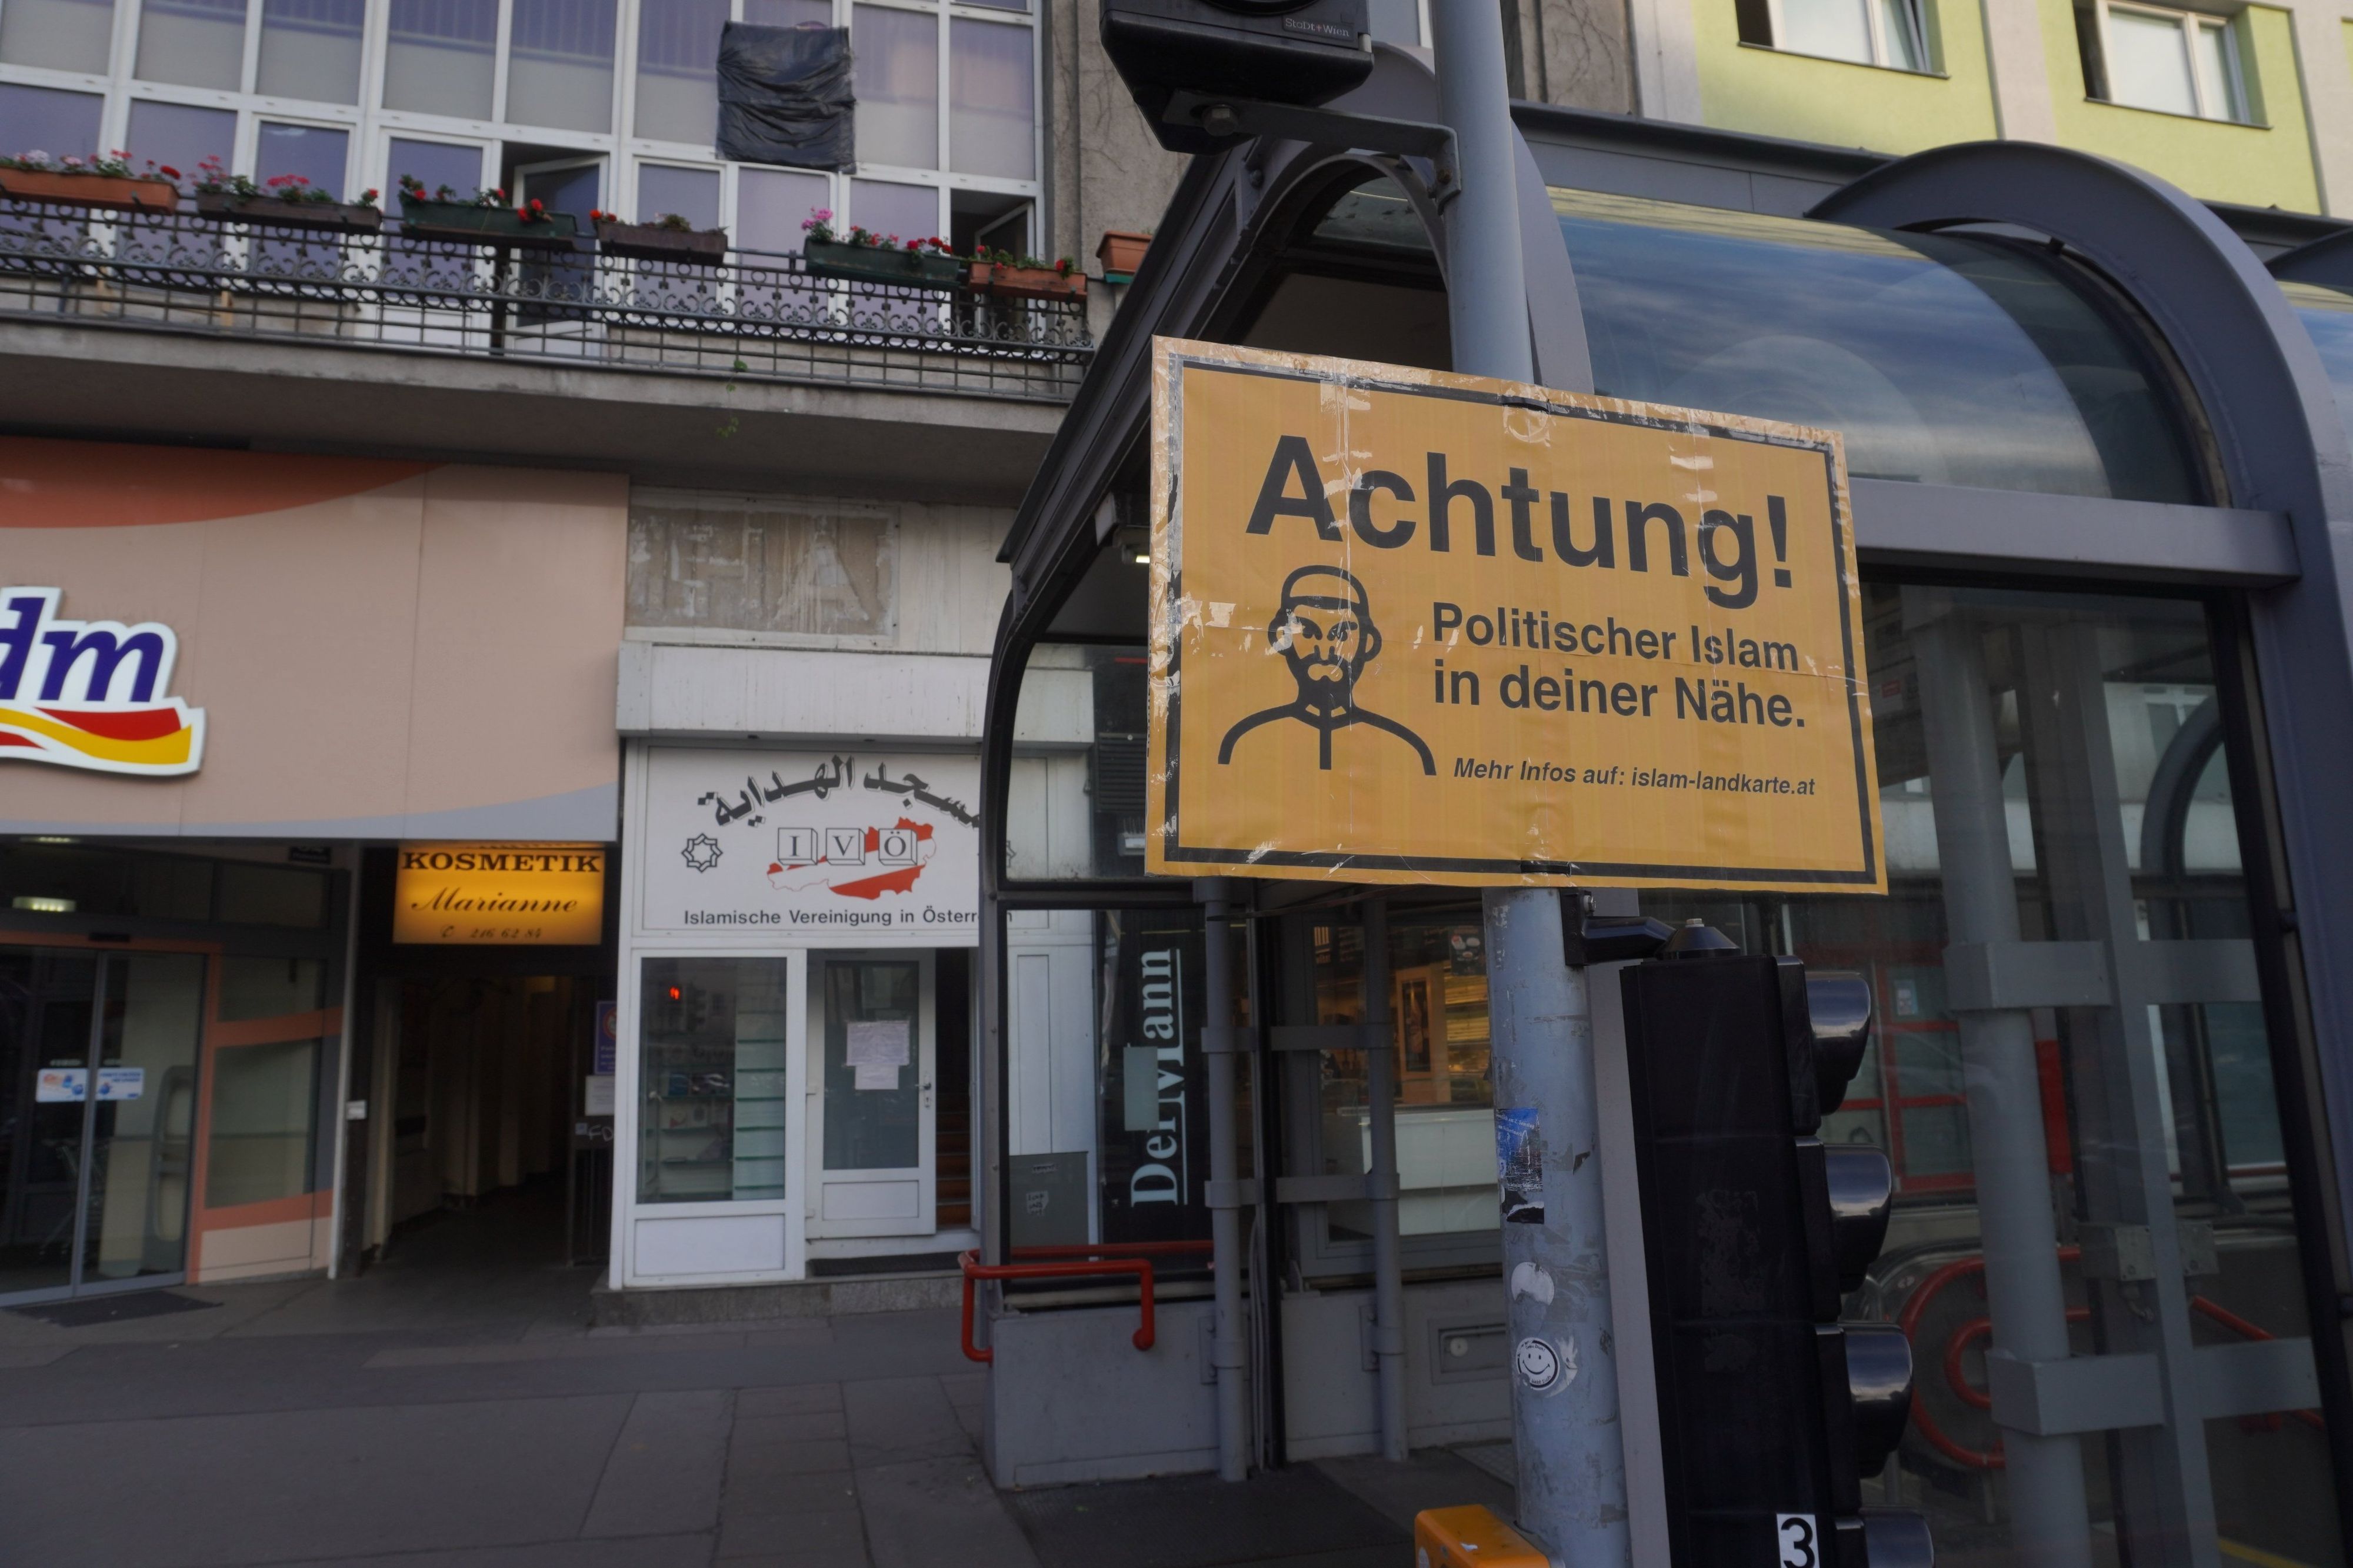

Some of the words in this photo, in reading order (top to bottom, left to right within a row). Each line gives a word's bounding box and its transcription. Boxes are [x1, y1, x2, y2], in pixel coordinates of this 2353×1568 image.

[1245, 434, 1793, 610] Achtung!
[0, 597, 164, 702] dm
[1433, 601, 1678, 661] Politischer
[1691, 625, 1799, 672] Islam
[1434, 658, 1480, 706] in
[1499, 664, 1659, 718] deiner
[1675, 677, 1805, 728] Nähe.
[1453, 757, 1515, 780] Mehr
[1519, 760, 1577, 784] Infos
[1582, 766, 1625, 786] auf:
[1631, 766, 1817, 796] islam-landkarte.at
[402, 852, 601, 872] KOSMETIK
[411, 886, 578, 913] Marianne
[684, 909, 781, 925] Islamische
[789, 909, 892, 928] Vereinigung
[900, 910, 915, 923] in
[1781, 1517, 1816, 1568] 3
